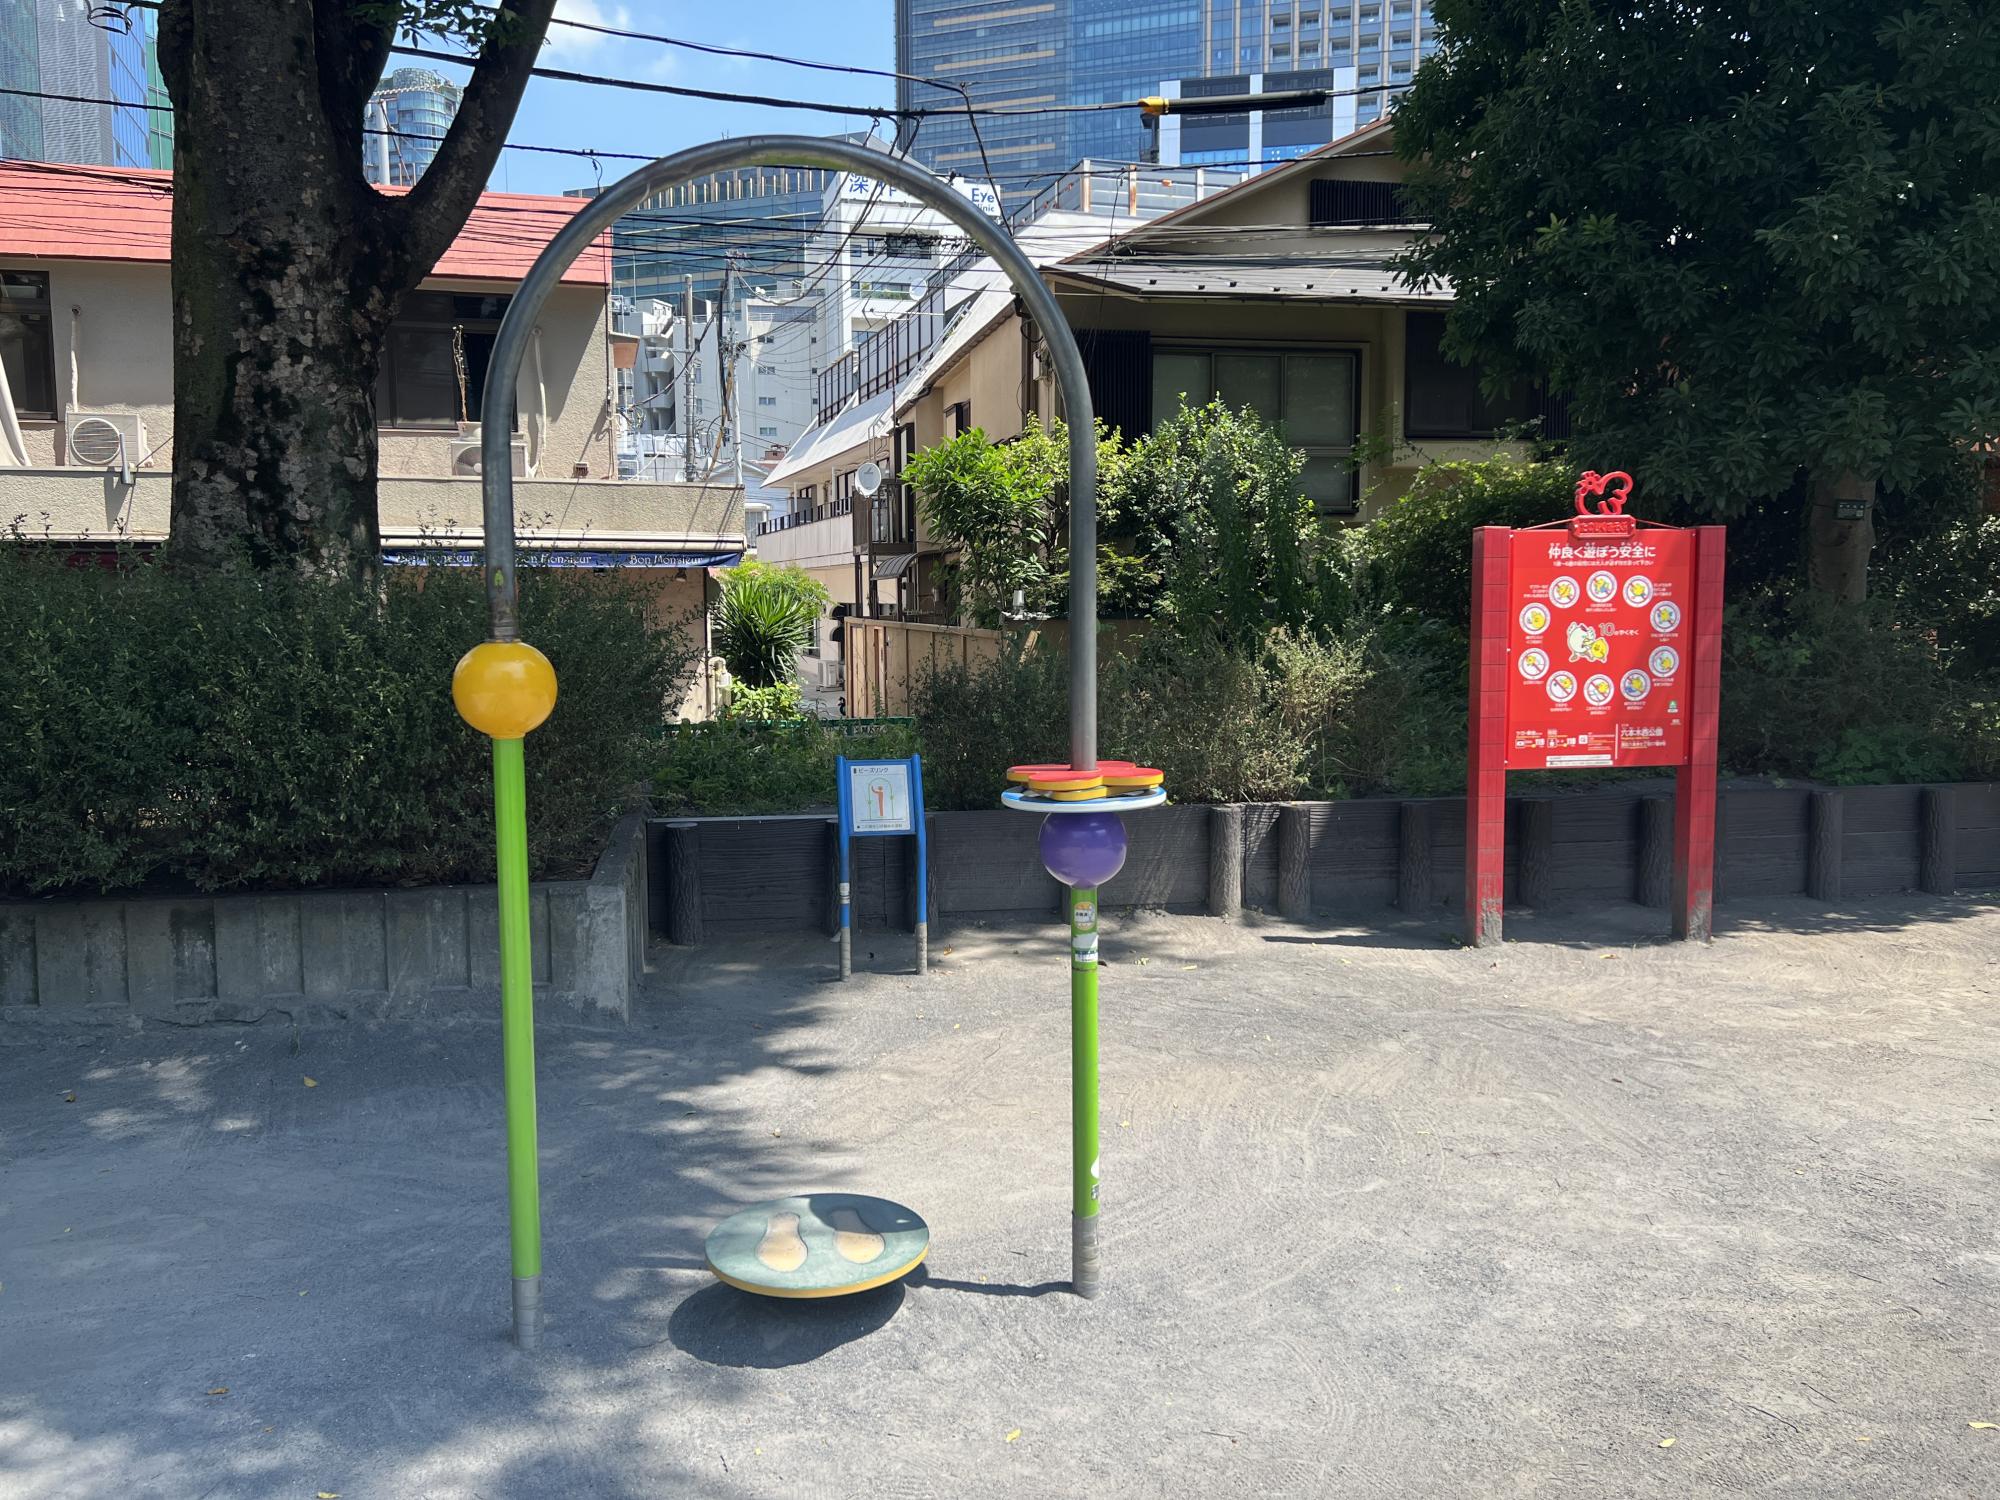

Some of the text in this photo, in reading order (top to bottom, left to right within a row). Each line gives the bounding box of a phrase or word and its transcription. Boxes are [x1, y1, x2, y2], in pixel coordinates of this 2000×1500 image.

[971, 187, 995, 203] Eye
[1548, 546, 1656, 559] 仲良く遊ぼう安全に
[629, 554, 703, 565] Bon Monsieur
